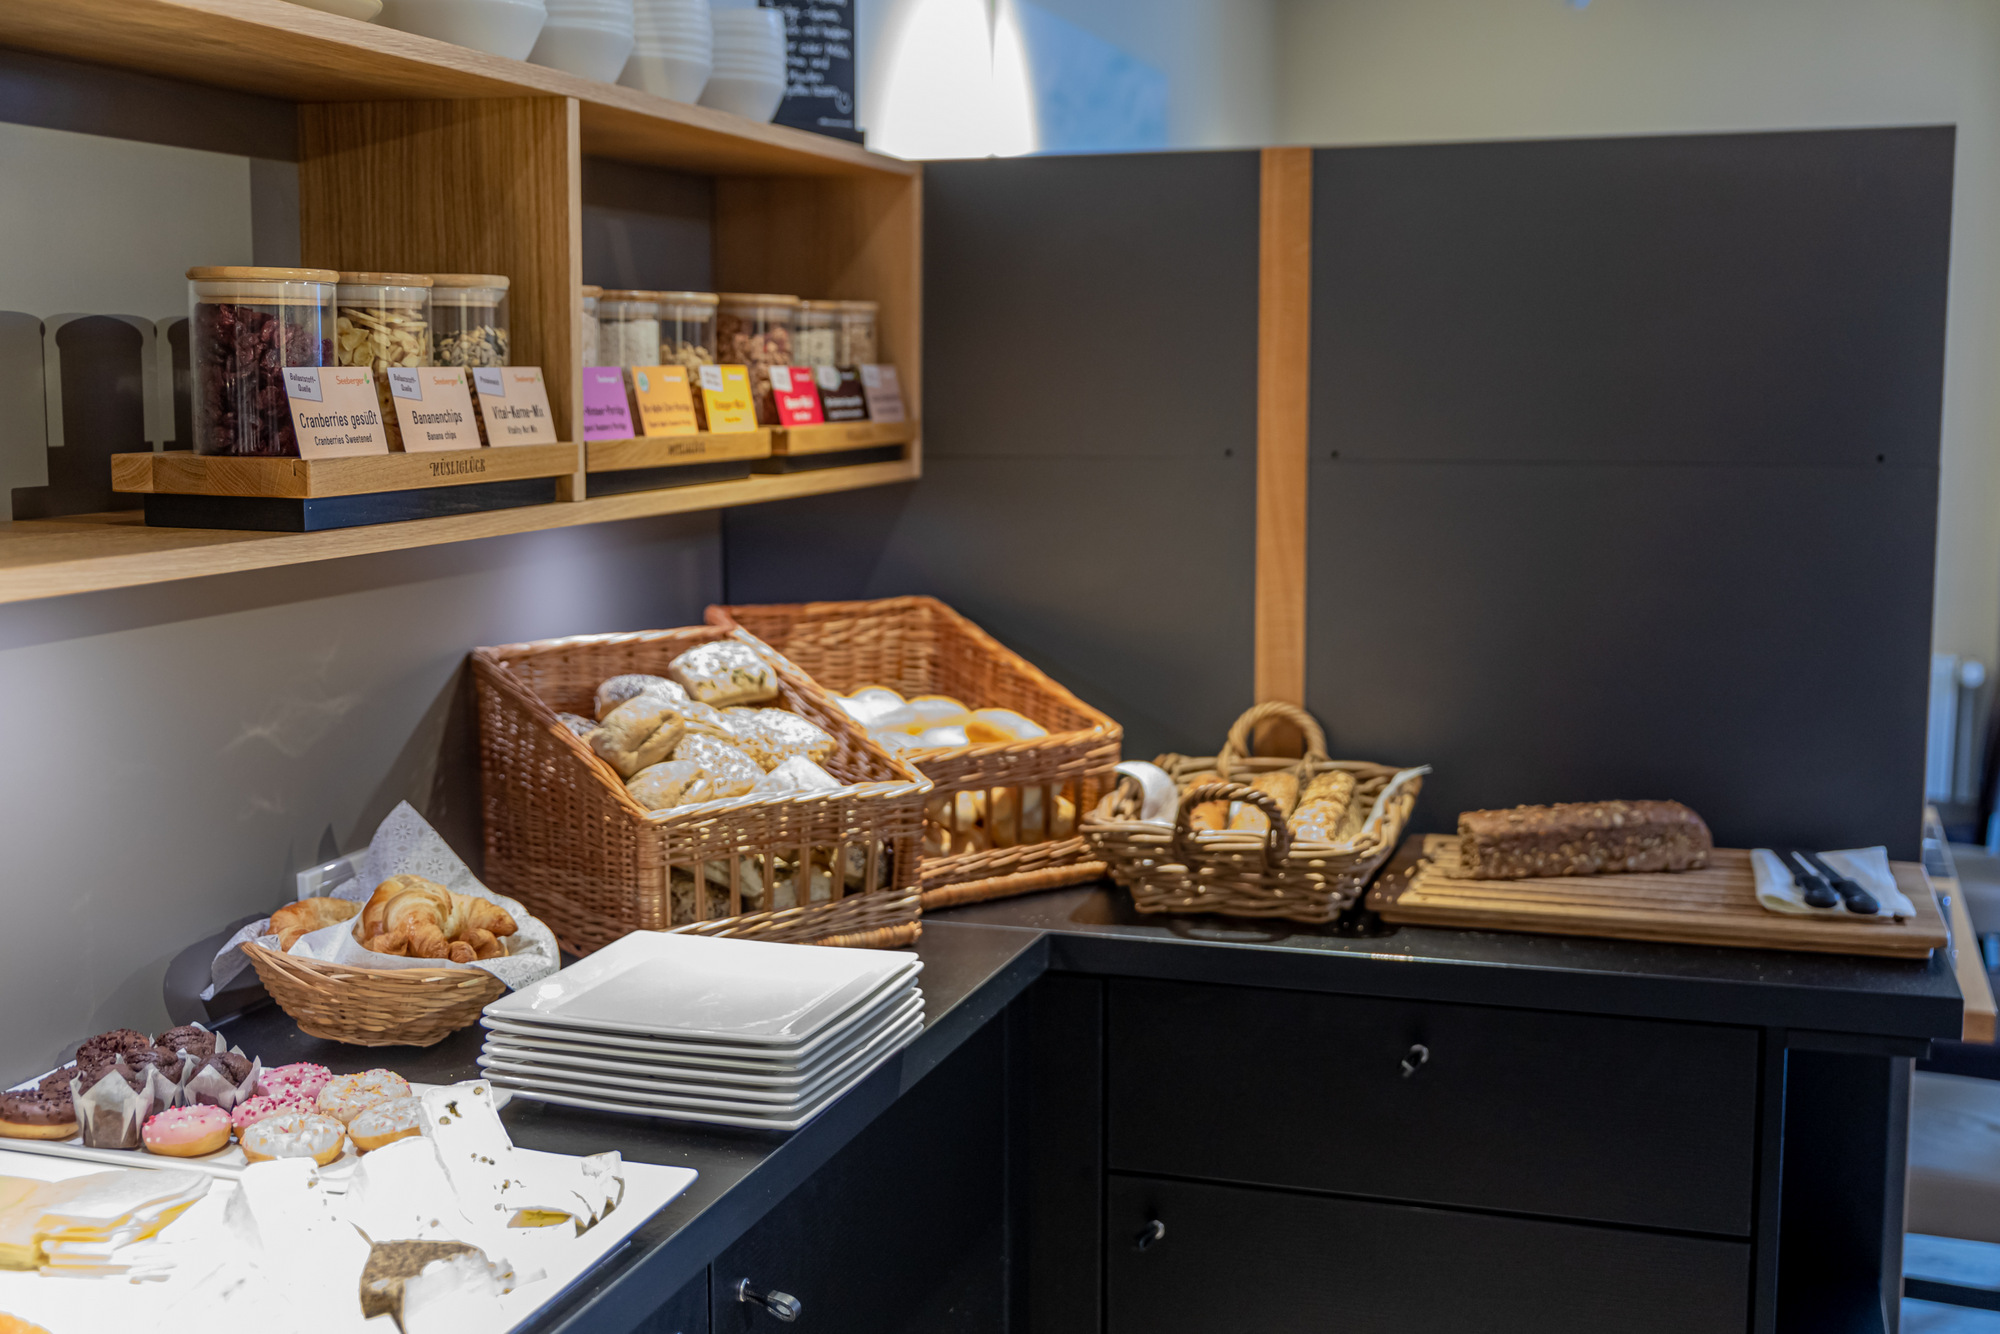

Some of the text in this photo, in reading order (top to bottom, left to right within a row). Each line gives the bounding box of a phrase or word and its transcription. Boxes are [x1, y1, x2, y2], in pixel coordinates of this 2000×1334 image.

[335, 375, 364, 386] Seeberger
[432, 375, 458, 387] Seeberger
[297, 383, 312, 393] Quelle
[412, 409, 463, 426] Bananenchips
[491, 404, 545, 420] Vital-Kerne-Mix
[299, 409, 379, 430] Cranberries gesüßt
[314, 433, 373, 446] Cranberries Sweetened
[426, 430, 457, 441] Banana chips
[429, 456, 486, 477] MÜSLIGLÜCK
